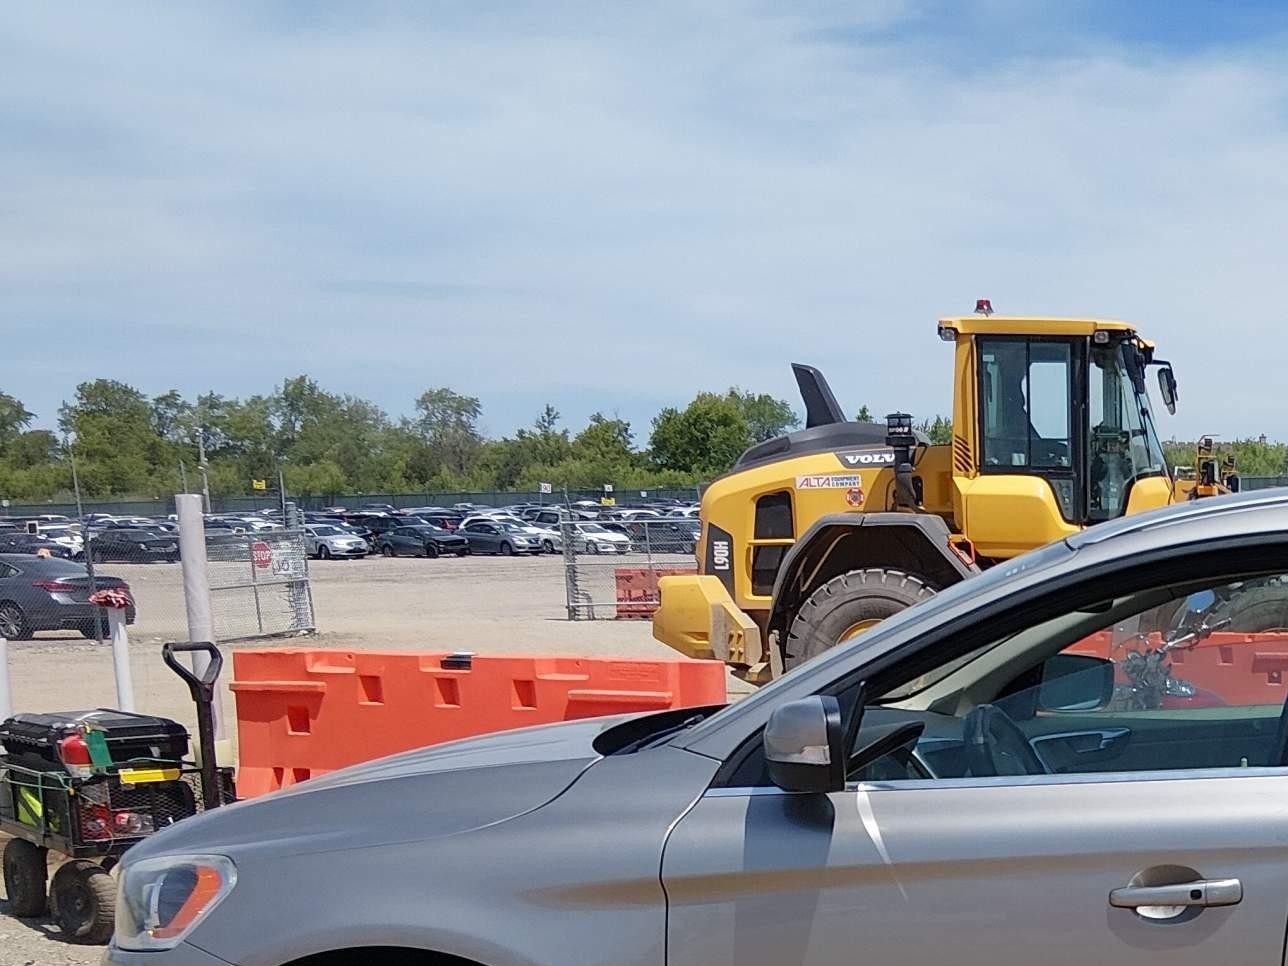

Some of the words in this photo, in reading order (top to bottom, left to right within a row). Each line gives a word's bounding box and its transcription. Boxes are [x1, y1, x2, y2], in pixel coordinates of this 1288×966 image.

[845, 452, 896, 464] VOLV
[799, 476, 831, 488] ALTA
[252, 550, 271, 561] STOP
[713, 541, 730, 570] L90H
